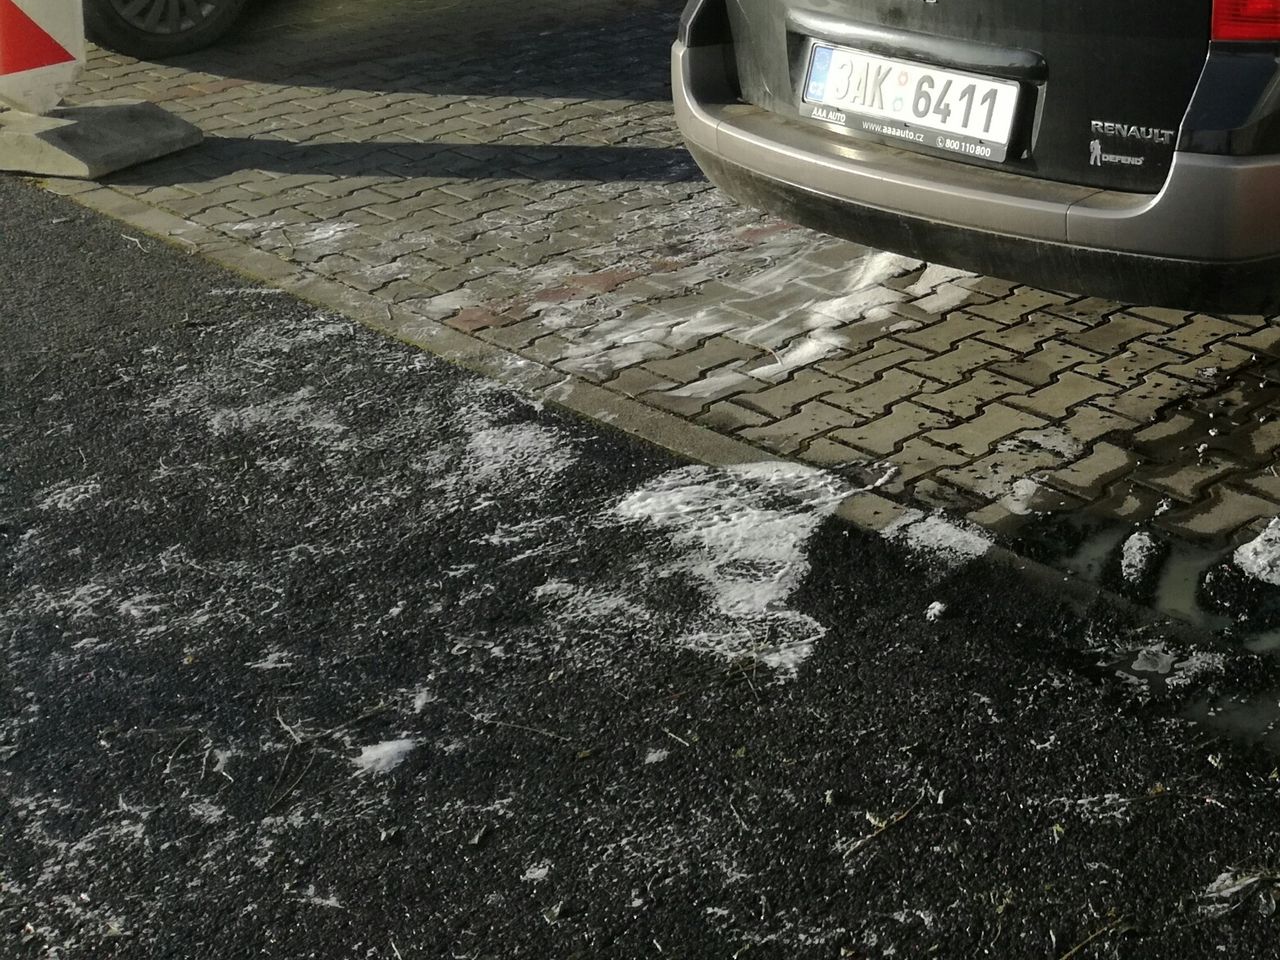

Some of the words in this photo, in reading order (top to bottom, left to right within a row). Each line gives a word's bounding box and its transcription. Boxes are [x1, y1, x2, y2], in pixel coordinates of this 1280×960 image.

[812, 106, 827, 119] AAA
[828, 109, 846, 123] AUTO
[911, 74, 999, 134] 6411
[862, 120, 924, 143] www.aaaauto.cz
[1090, 120, 1175, 144] RENAULT
[944, 138, 960, 151] 800
[960, 141, 975, 154] 110
[975, 144, 991, 158] 800
